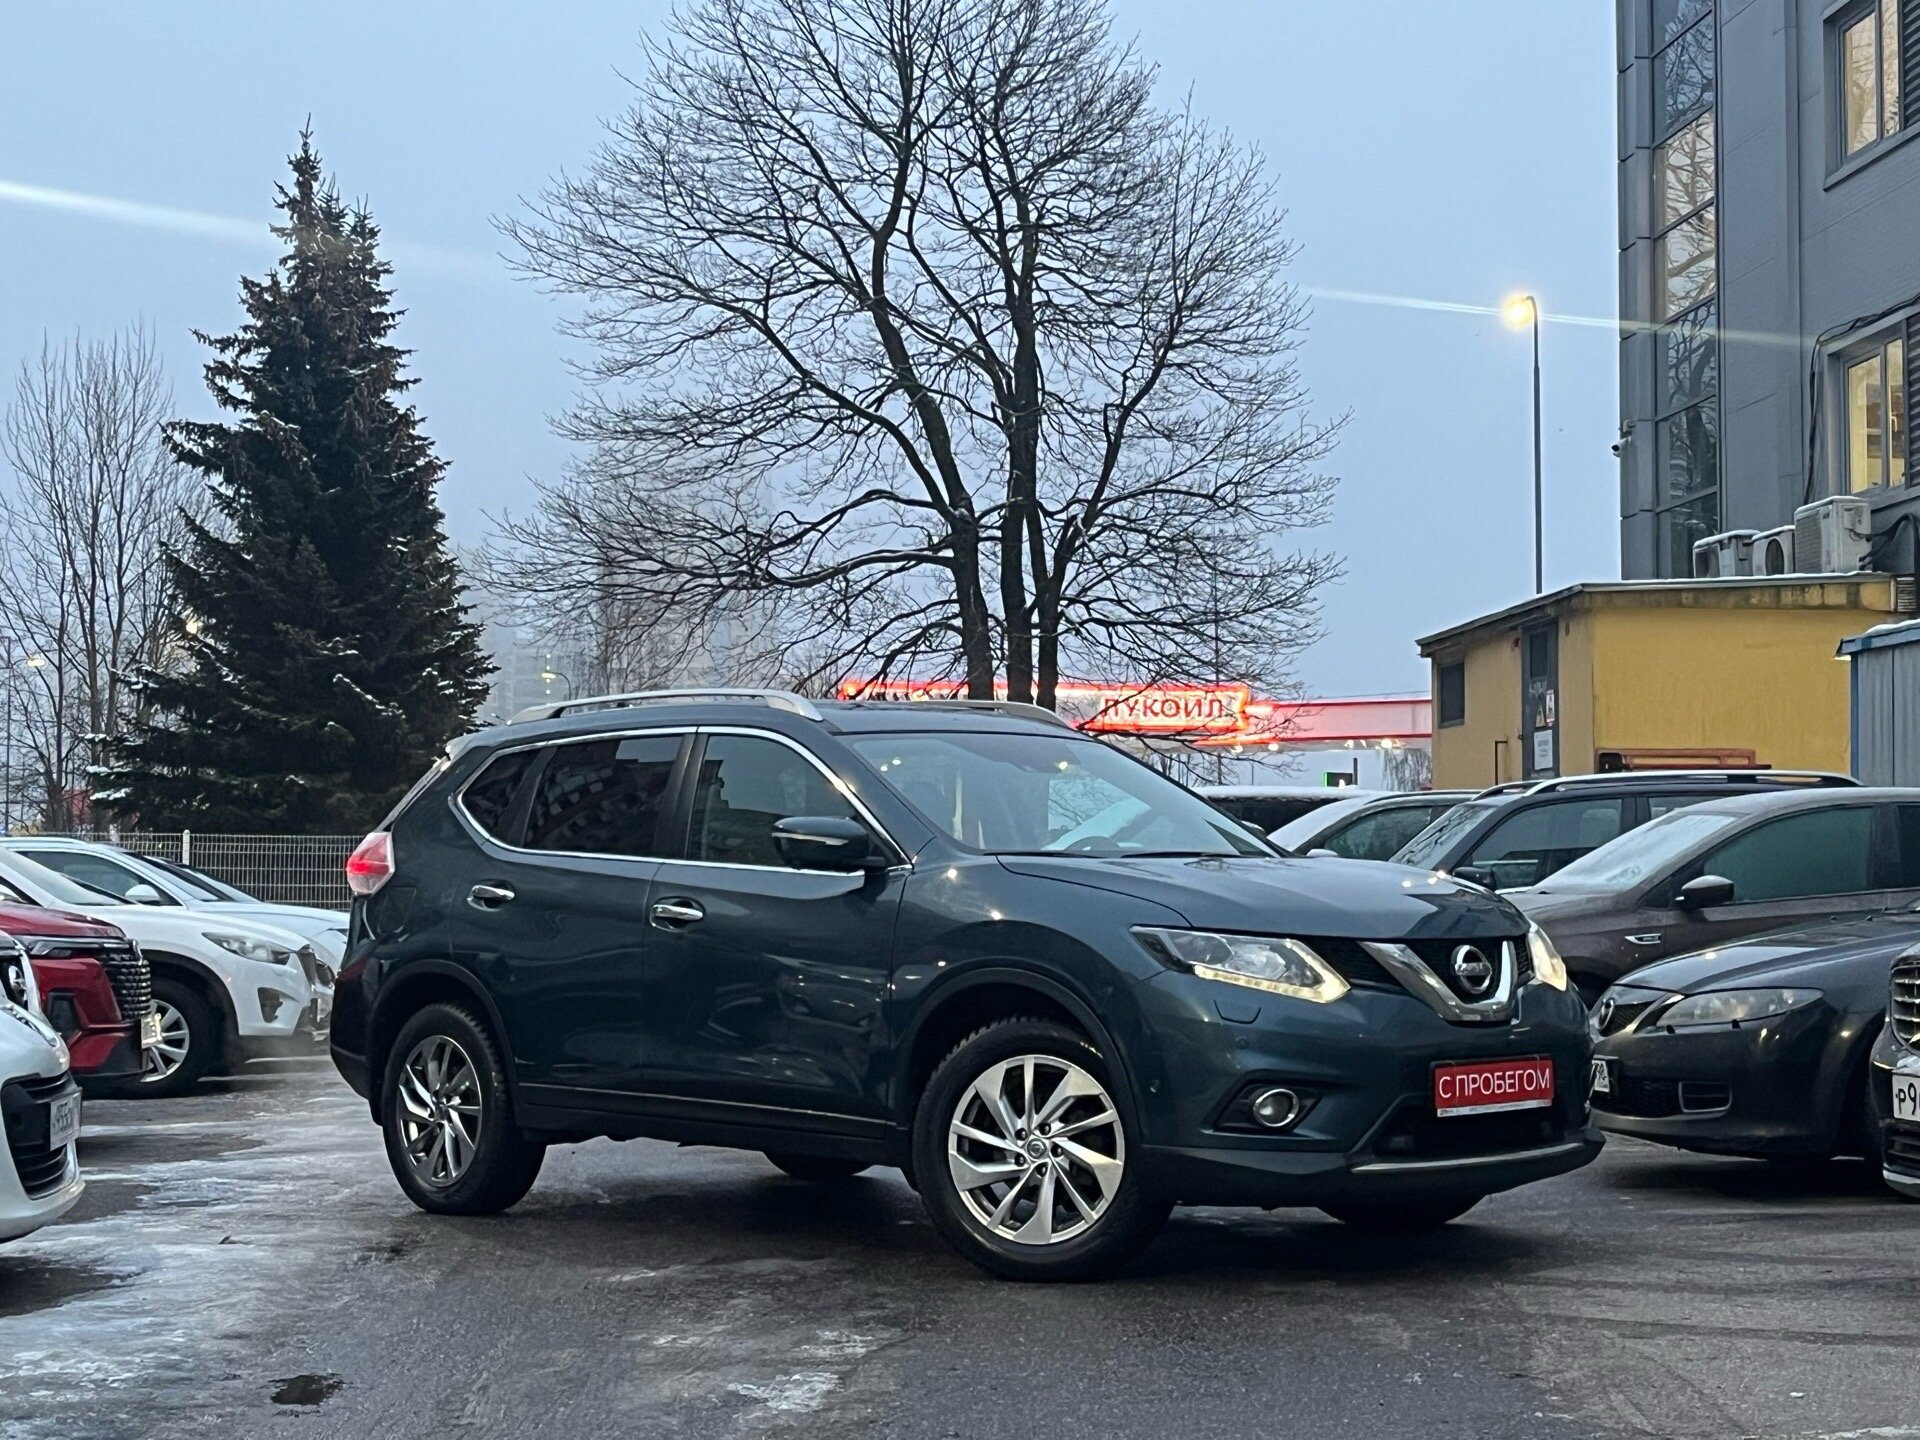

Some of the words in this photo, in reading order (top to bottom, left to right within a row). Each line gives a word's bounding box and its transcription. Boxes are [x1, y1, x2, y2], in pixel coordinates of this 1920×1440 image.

[1439, 1076, 1452, 1098] С
[1456, 1067, 1550, 1097] ПРОБЕГОМ
[1897, 1082, 1920, 1116] Р9
